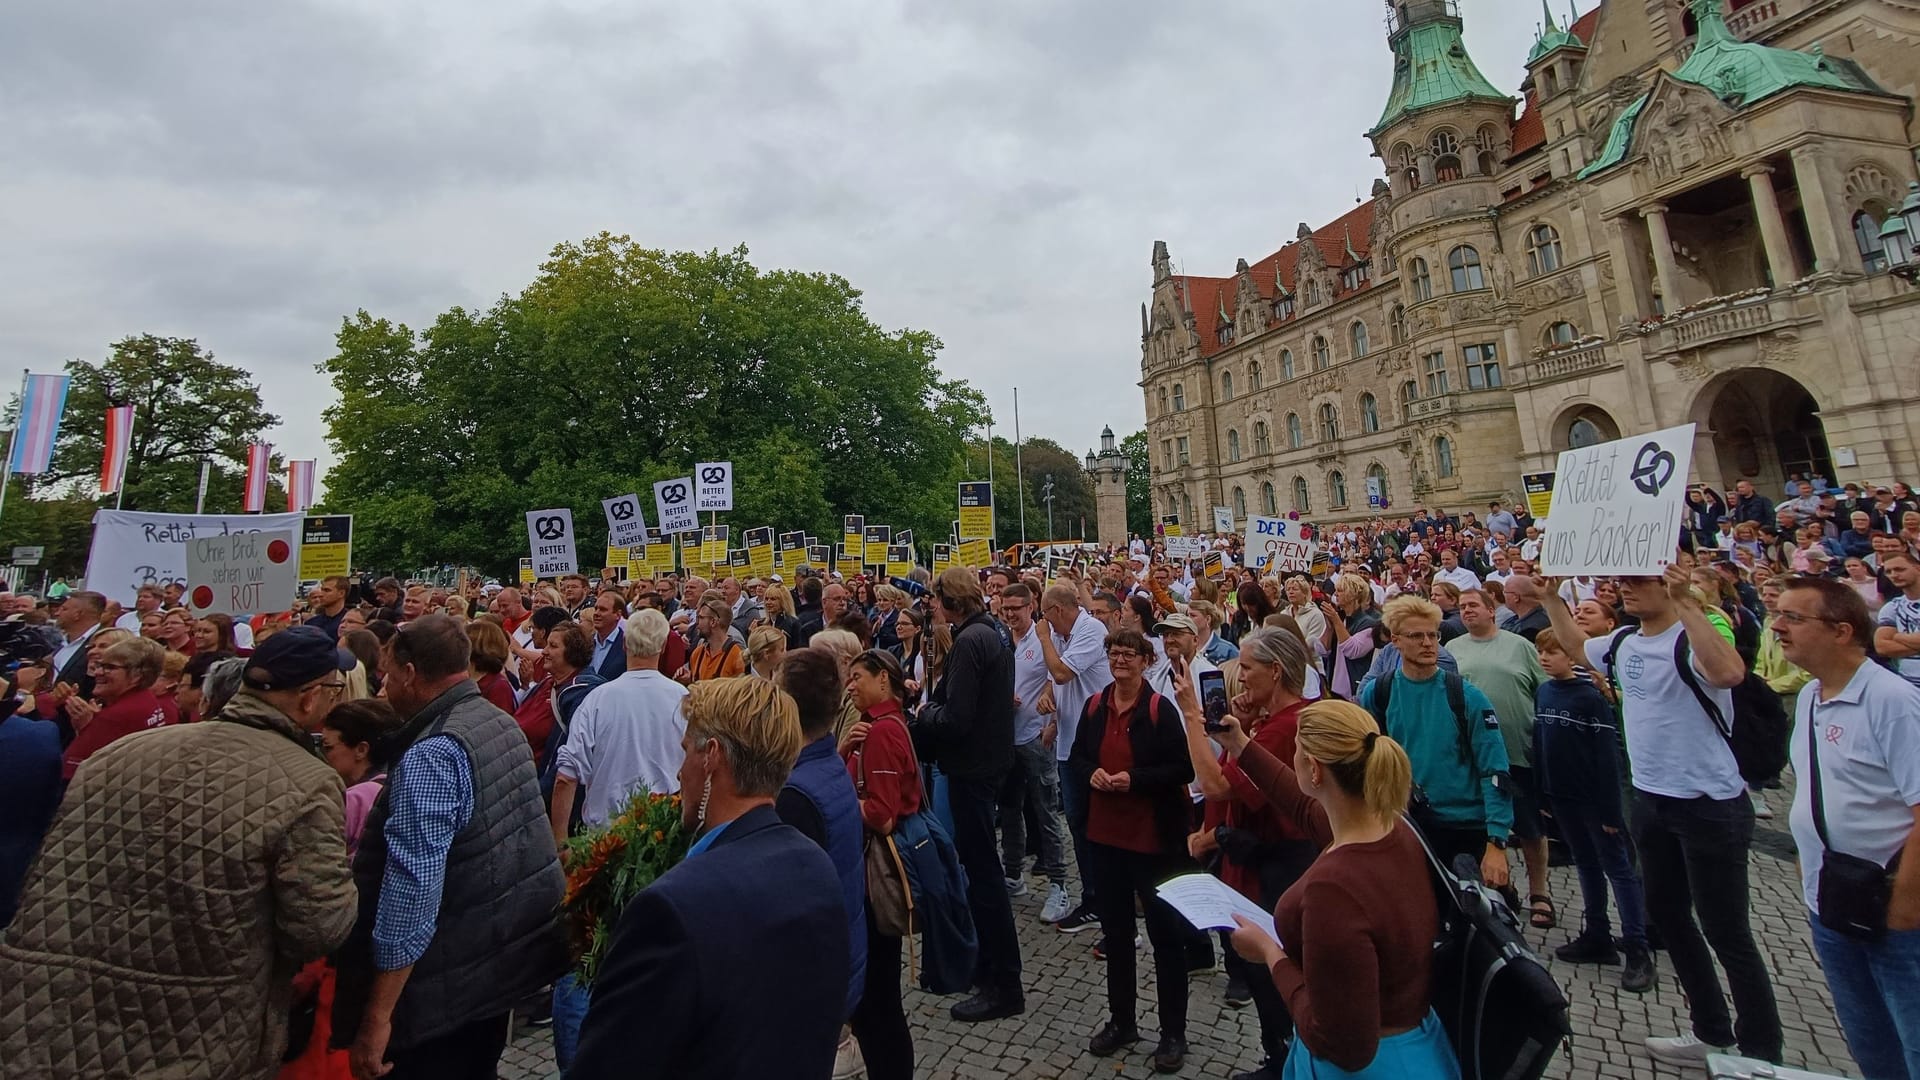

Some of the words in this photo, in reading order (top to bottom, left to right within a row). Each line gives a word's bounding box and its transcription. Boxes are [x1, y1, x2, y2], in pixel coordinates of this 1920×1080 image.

[1558, 443, 1618, 505] Rettet
[702, 487, 725, 495] RETTET
[701, 498, 726, 508] BÄCKER
[664, 505, 688, 517] RETTET
[616, 521, 638, 533] RETTET
[665, 518, 692, 531] BÄCKER
[1256, 520, 1286, 537] DER
[141, 521, 196, 543] Rettet
[618, 534, 643, 546] BÄCKER
[196, 538, 225, 563] Ohne
[539, 545, 566, 555] RETTET
[1547, 530, 1576, 567] uns
[539, 561, 570, 573] BÄCKER
[1256, 556, 1267, 567] IS
[1280, 559, 1311, 573] AUS!
[212, 563, 241, 584] sehen
[246, 561, 265, 581] wir
[231, 582, 264, 611] ROT
